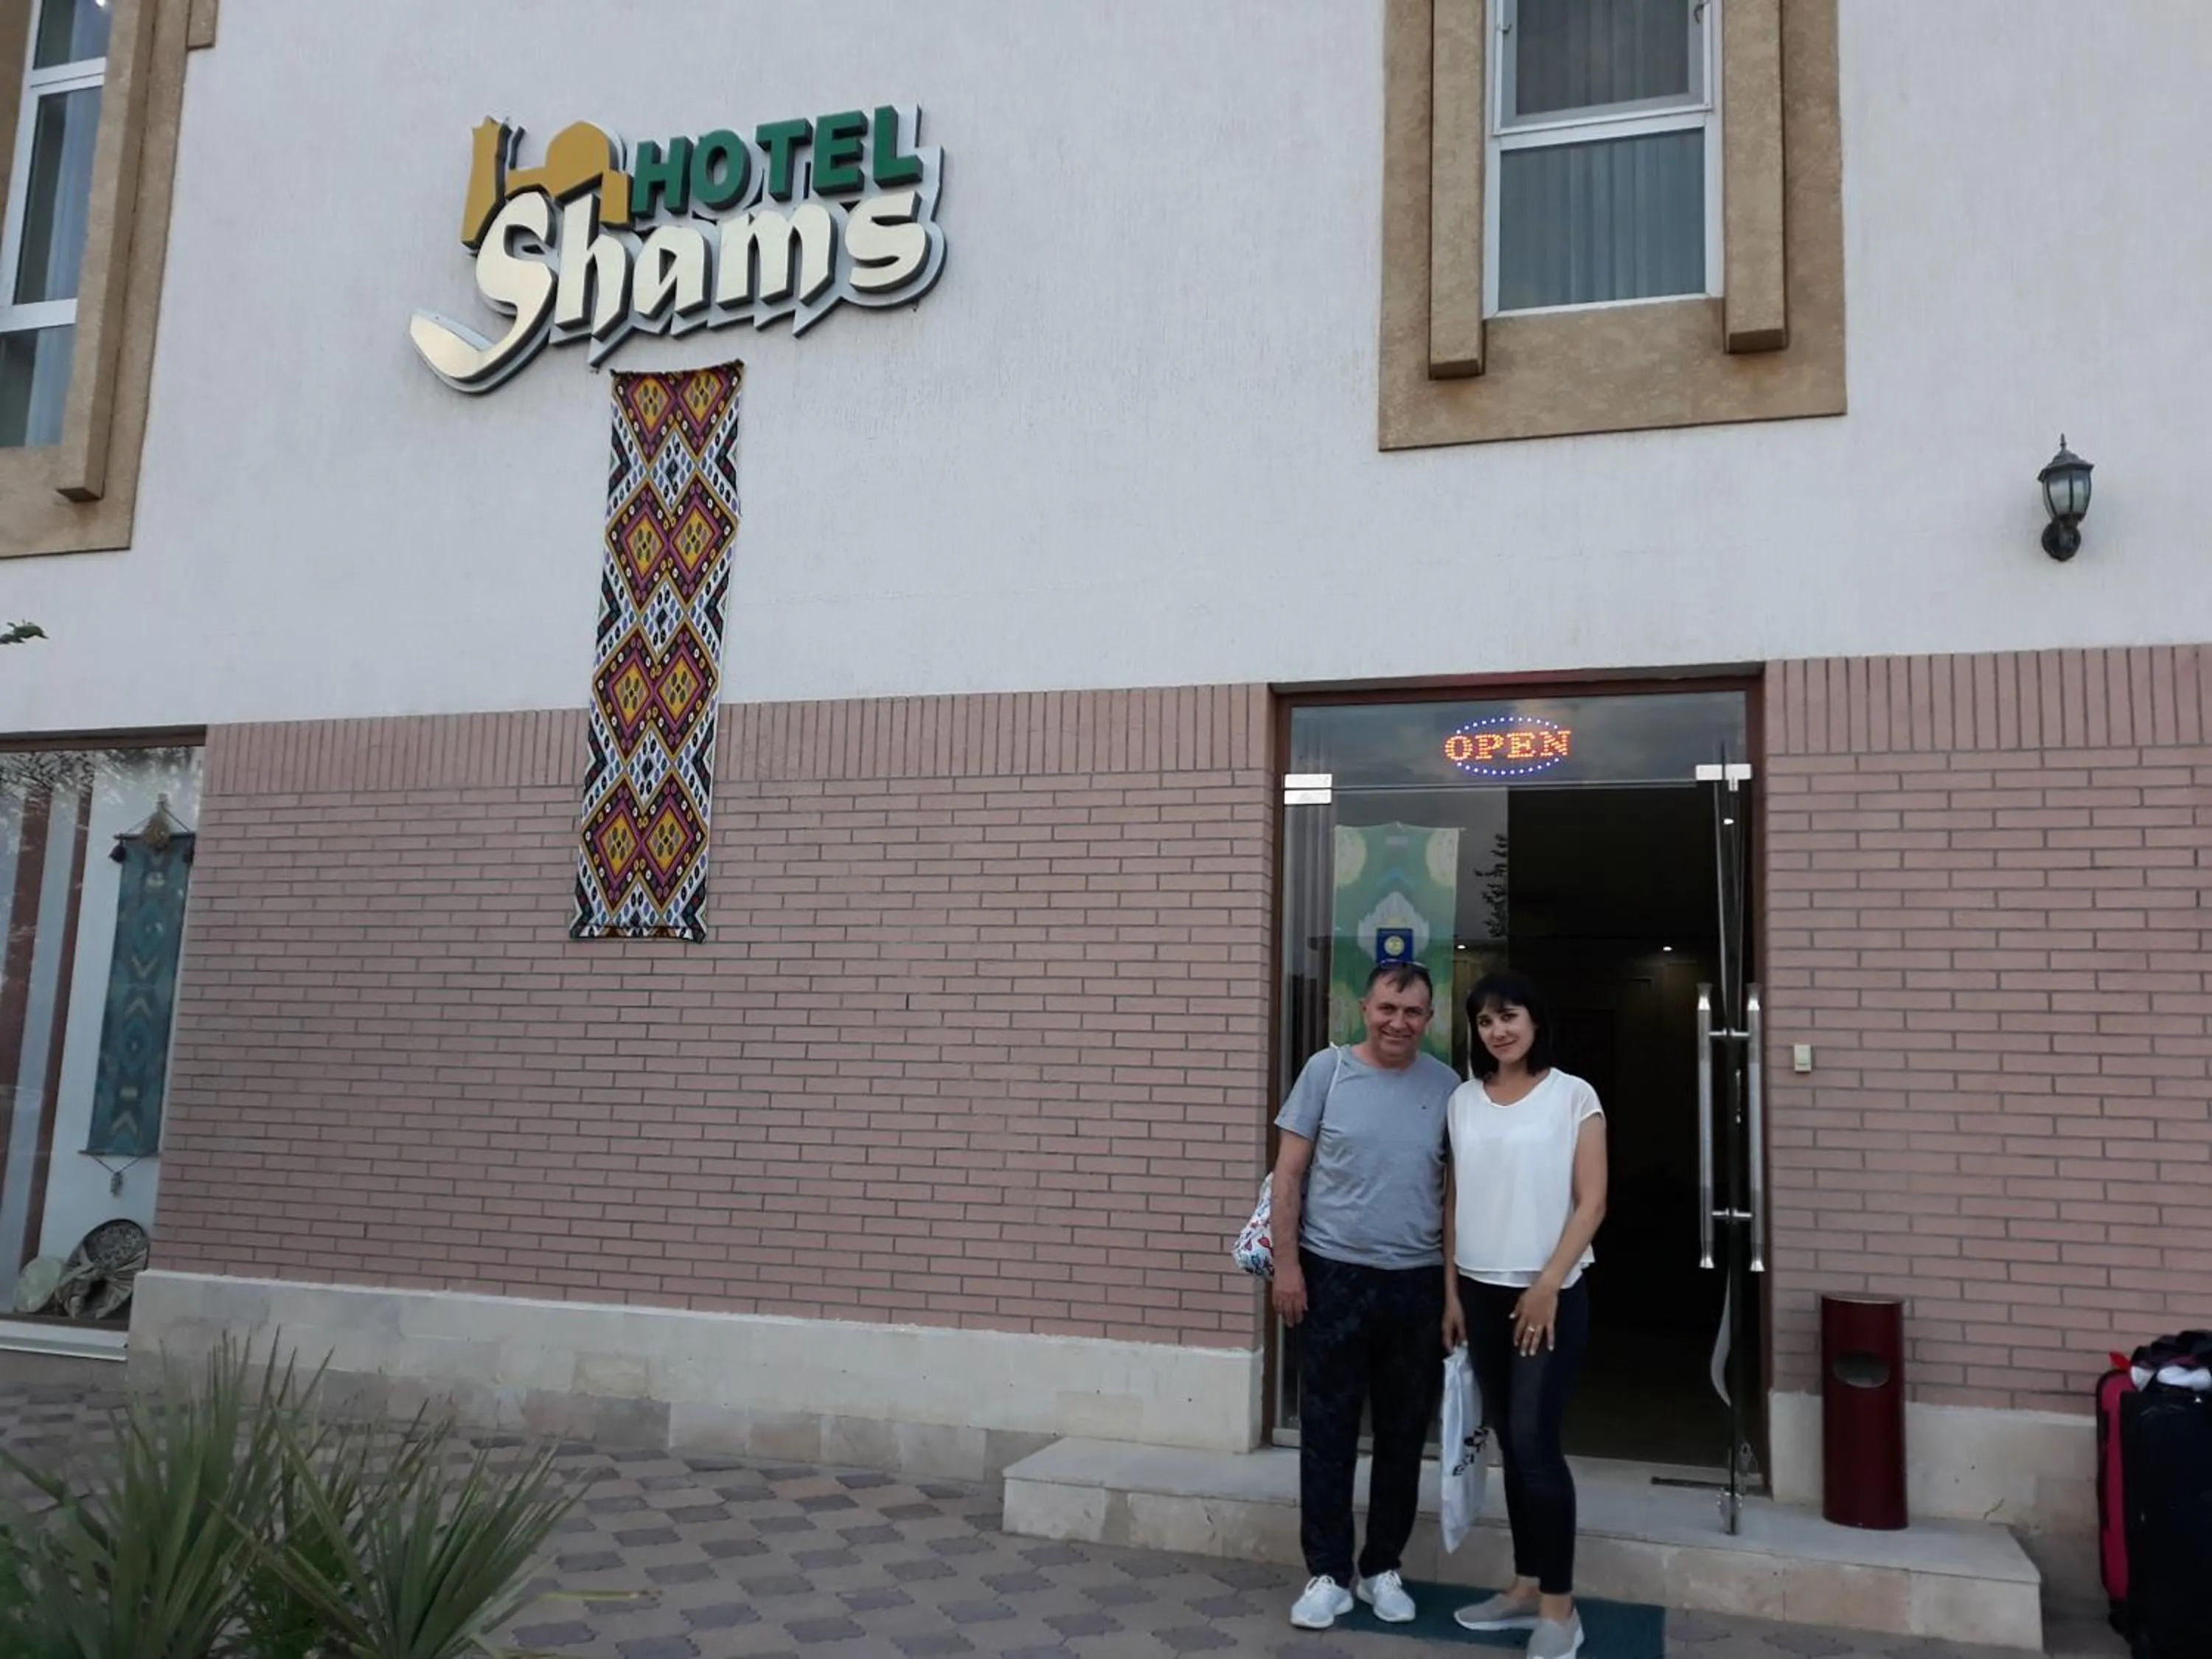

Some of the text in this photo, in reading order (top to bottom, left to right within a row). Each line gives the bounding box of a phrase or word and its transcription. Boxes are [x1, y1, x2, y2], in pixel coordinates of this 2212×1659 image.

[632, 105, 924, 218] HOTEL
[410, 189, 931, 382] Shams
[1444, 731, 1571, 761] OPEN
